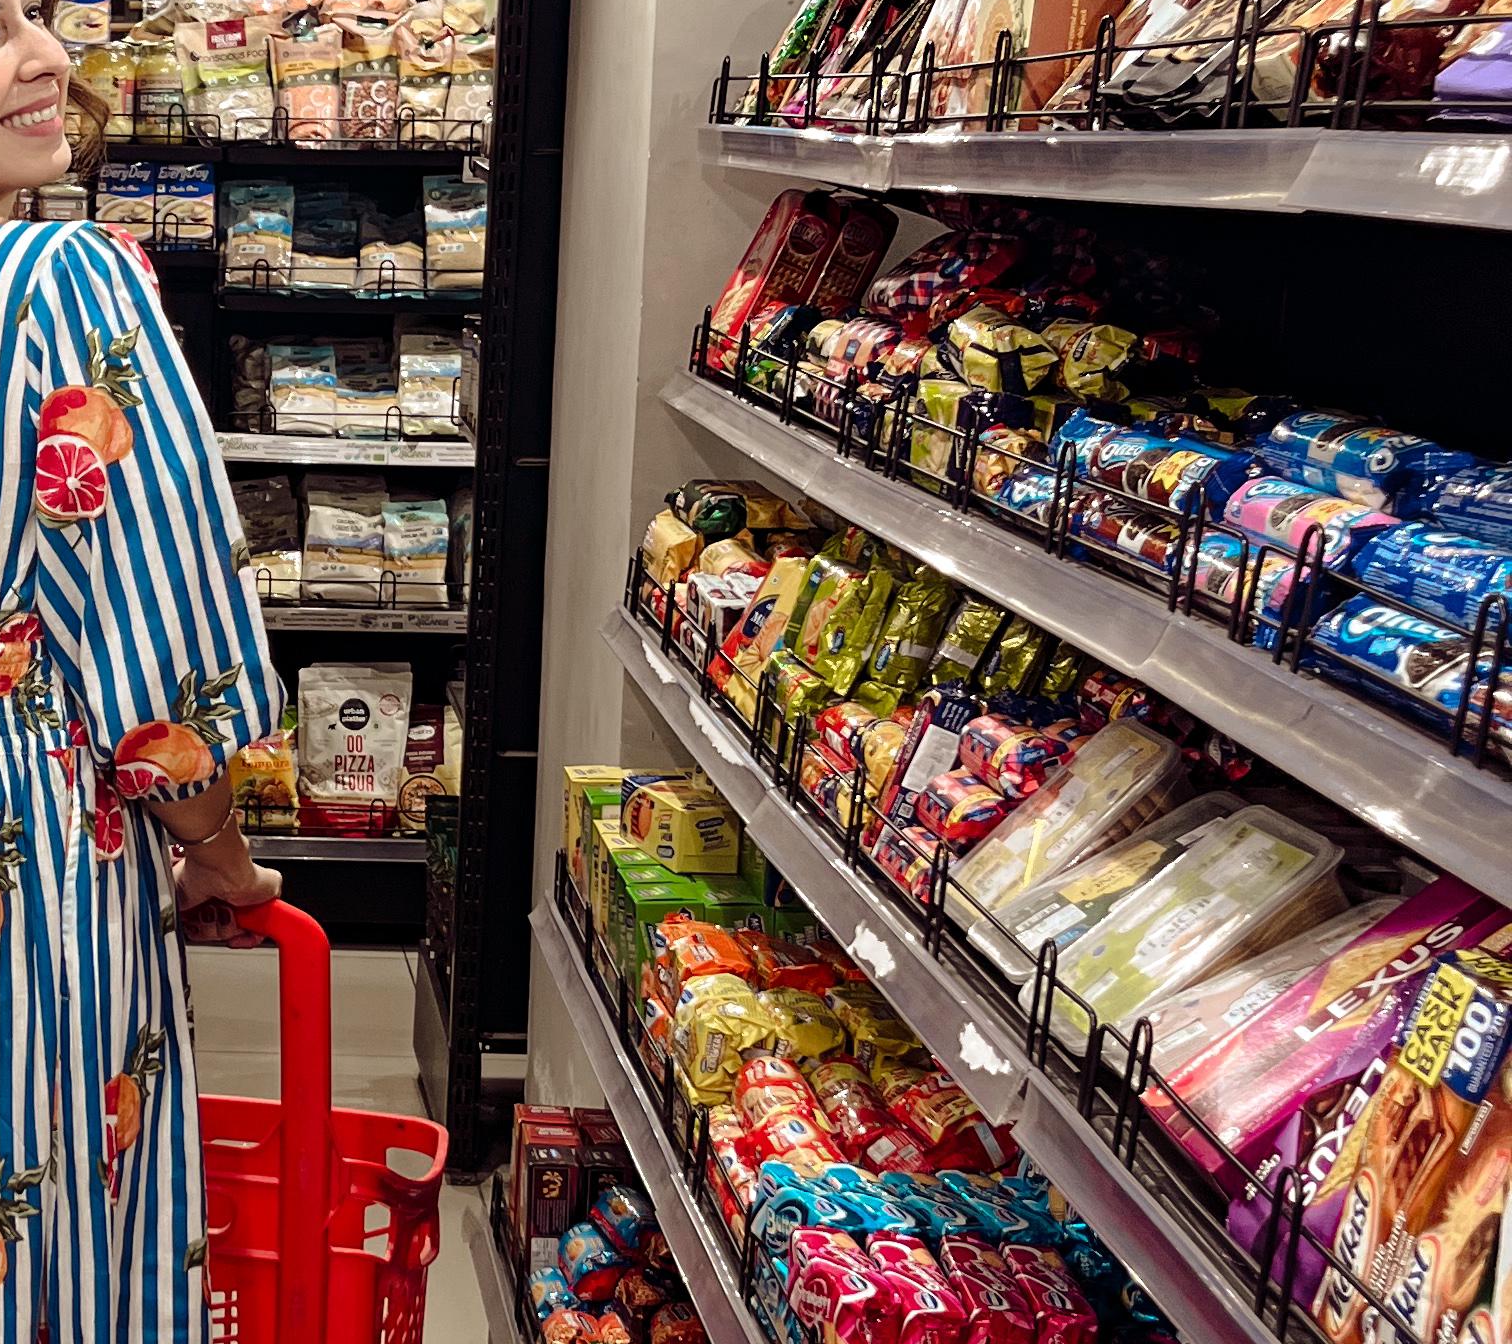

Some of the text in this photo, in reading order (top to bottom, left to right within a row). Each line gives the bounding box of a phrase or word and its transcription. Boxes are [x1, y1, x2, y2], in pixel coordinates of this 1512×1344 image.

[1099, 439, 1144, 460] OREO
[1346, 606, 1466, 641] OREO
[334, 755, 376, 773] PIZZA
[334, 774, 375, 792] FLOUR
[1292, 920, 1464, 1043] LEXUS
[1403, 974, 1452, 1066] CASH
[1416, 992, 1466, 1076] BACK
[1288, 1056, 1388, 1207] LEXUS
[1327, 1179, 1371, 1319] Makist
